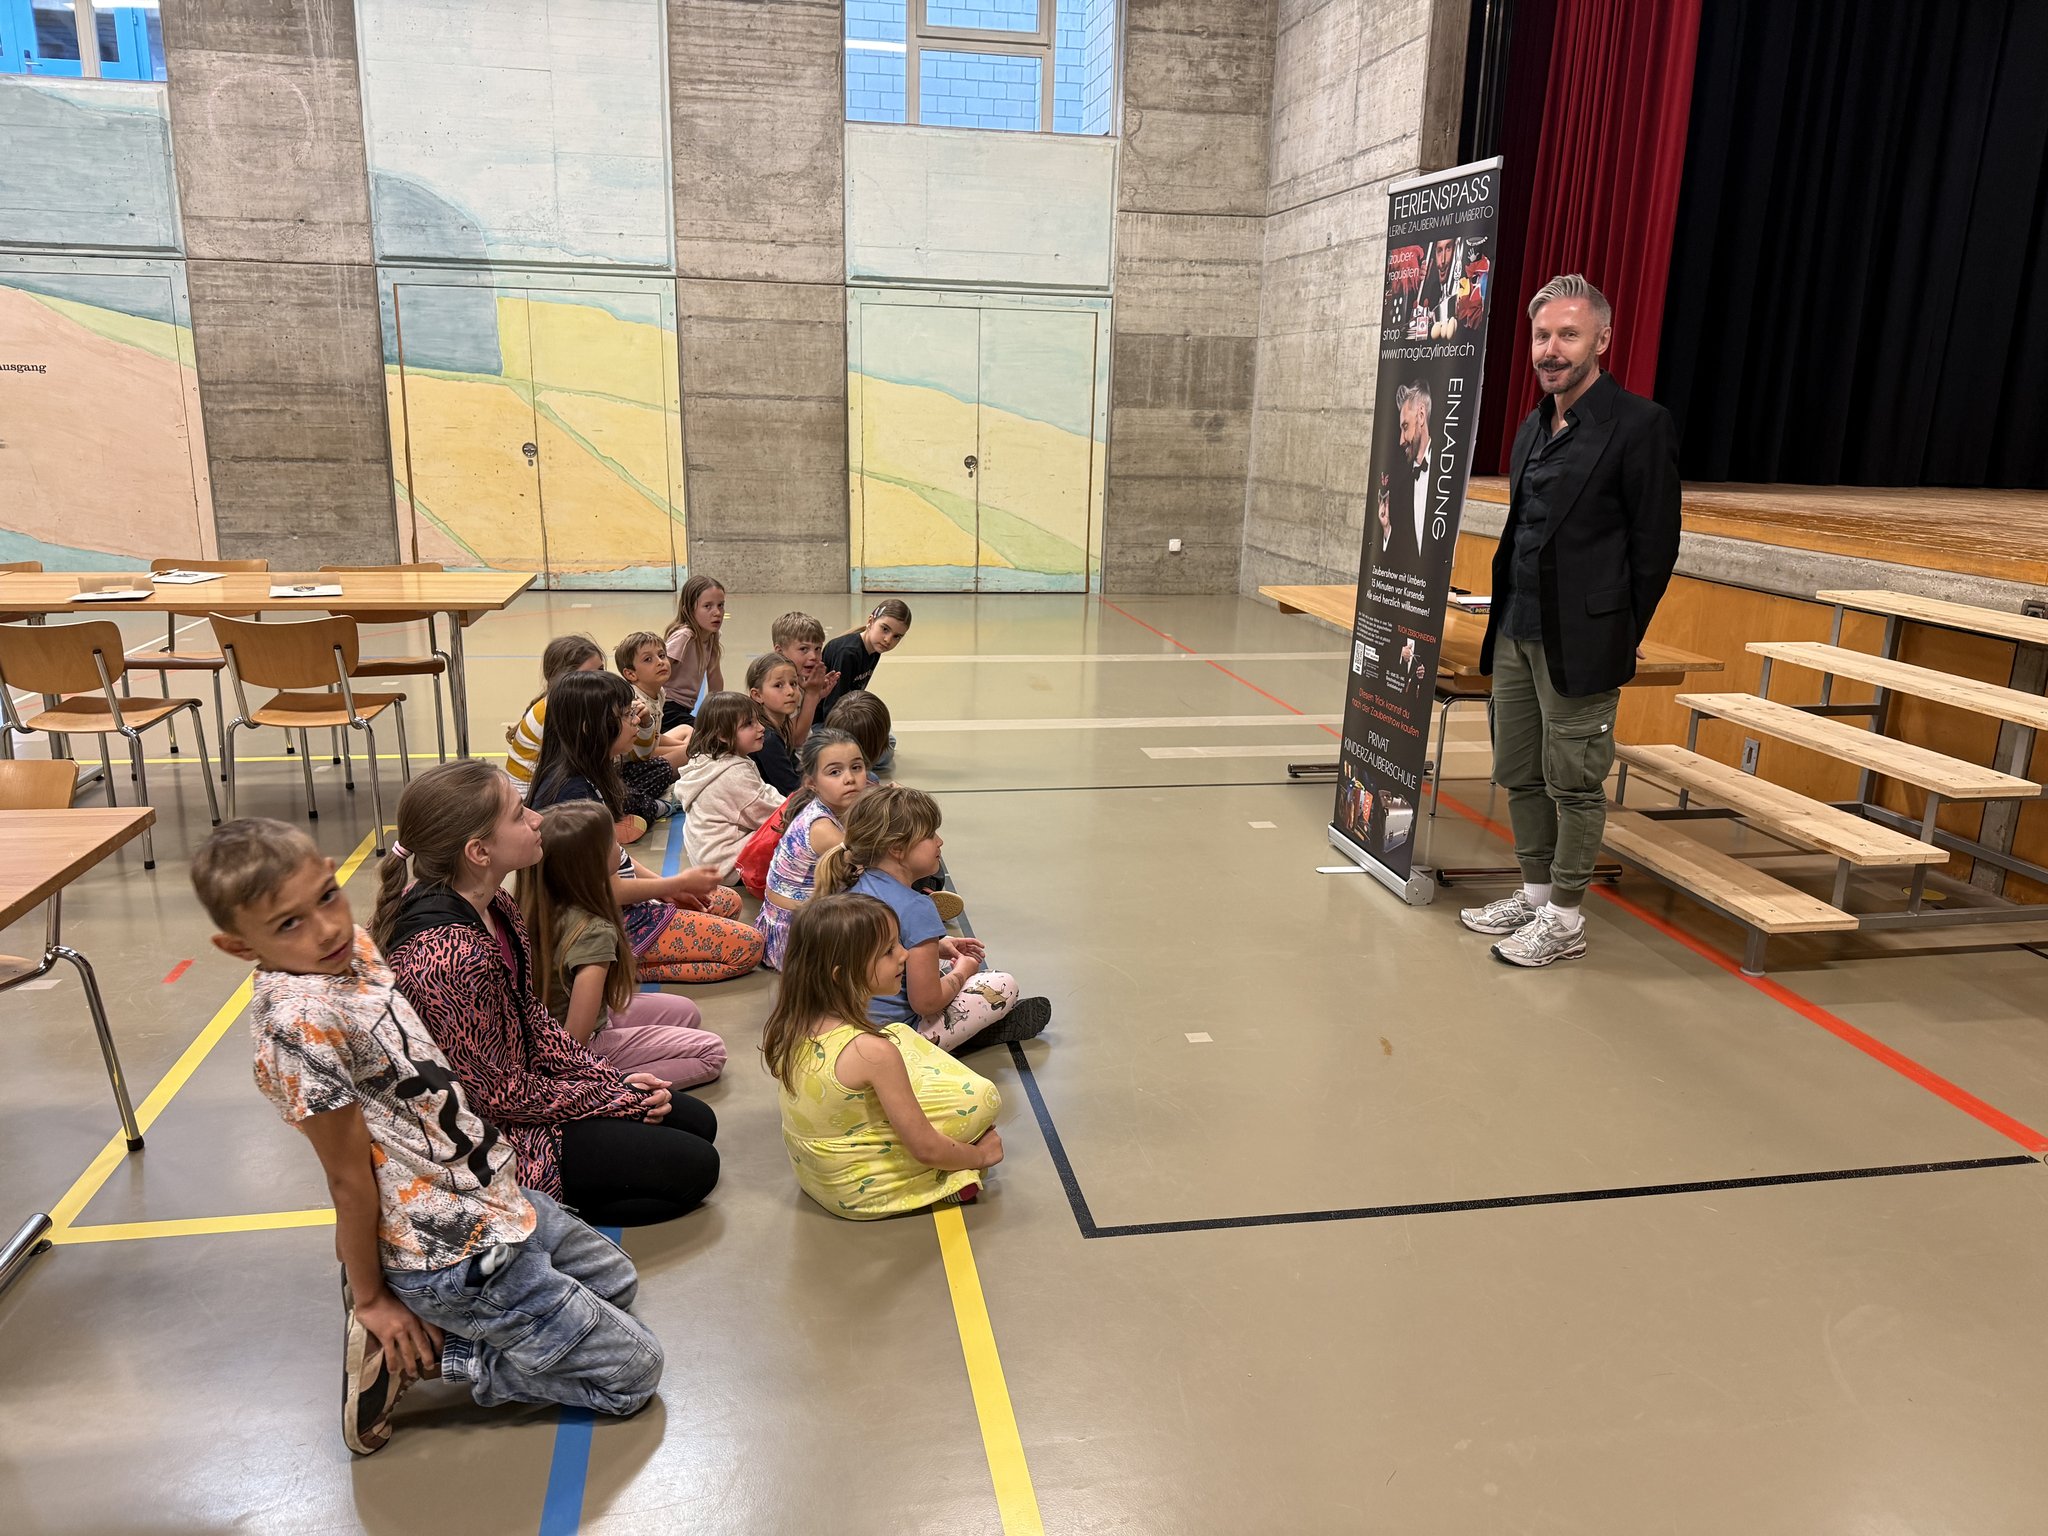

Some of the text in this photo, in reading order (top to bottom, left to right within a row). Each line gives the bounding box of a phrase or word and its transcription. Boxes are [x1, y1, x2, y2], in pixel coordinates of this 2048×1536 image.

[1394, 175, 1491, 220] FERIENSPASS
[1389, 205, 1494, 237] LERNE ZAUBERN MIT UMBERTO
[1381, 342, 1475, 361] www.magiczylinder.ch
[1432, 378, 1463, 540] EINLADUNG
[1372, 564, 1398, 580] Zaubershow
[1407, 574, 1426, 588] Umberto
[1376, 580, 1395, 593] Minuten
[1395, 587, 1403, 595] vor
[1403, 586, 1425, 602] Kursende
[1372, 592, 1381, 603] sind
[1382, 594, 1400, 608] herzlich
[1401, 600, 1430, 617] willkommen!
[1367, 729, 1390, 753] PRIVAT
[1400, 720, 1420, 738] kaufen
[1344, 736, 1417, 790] KINDERZAUBERSCHULE
